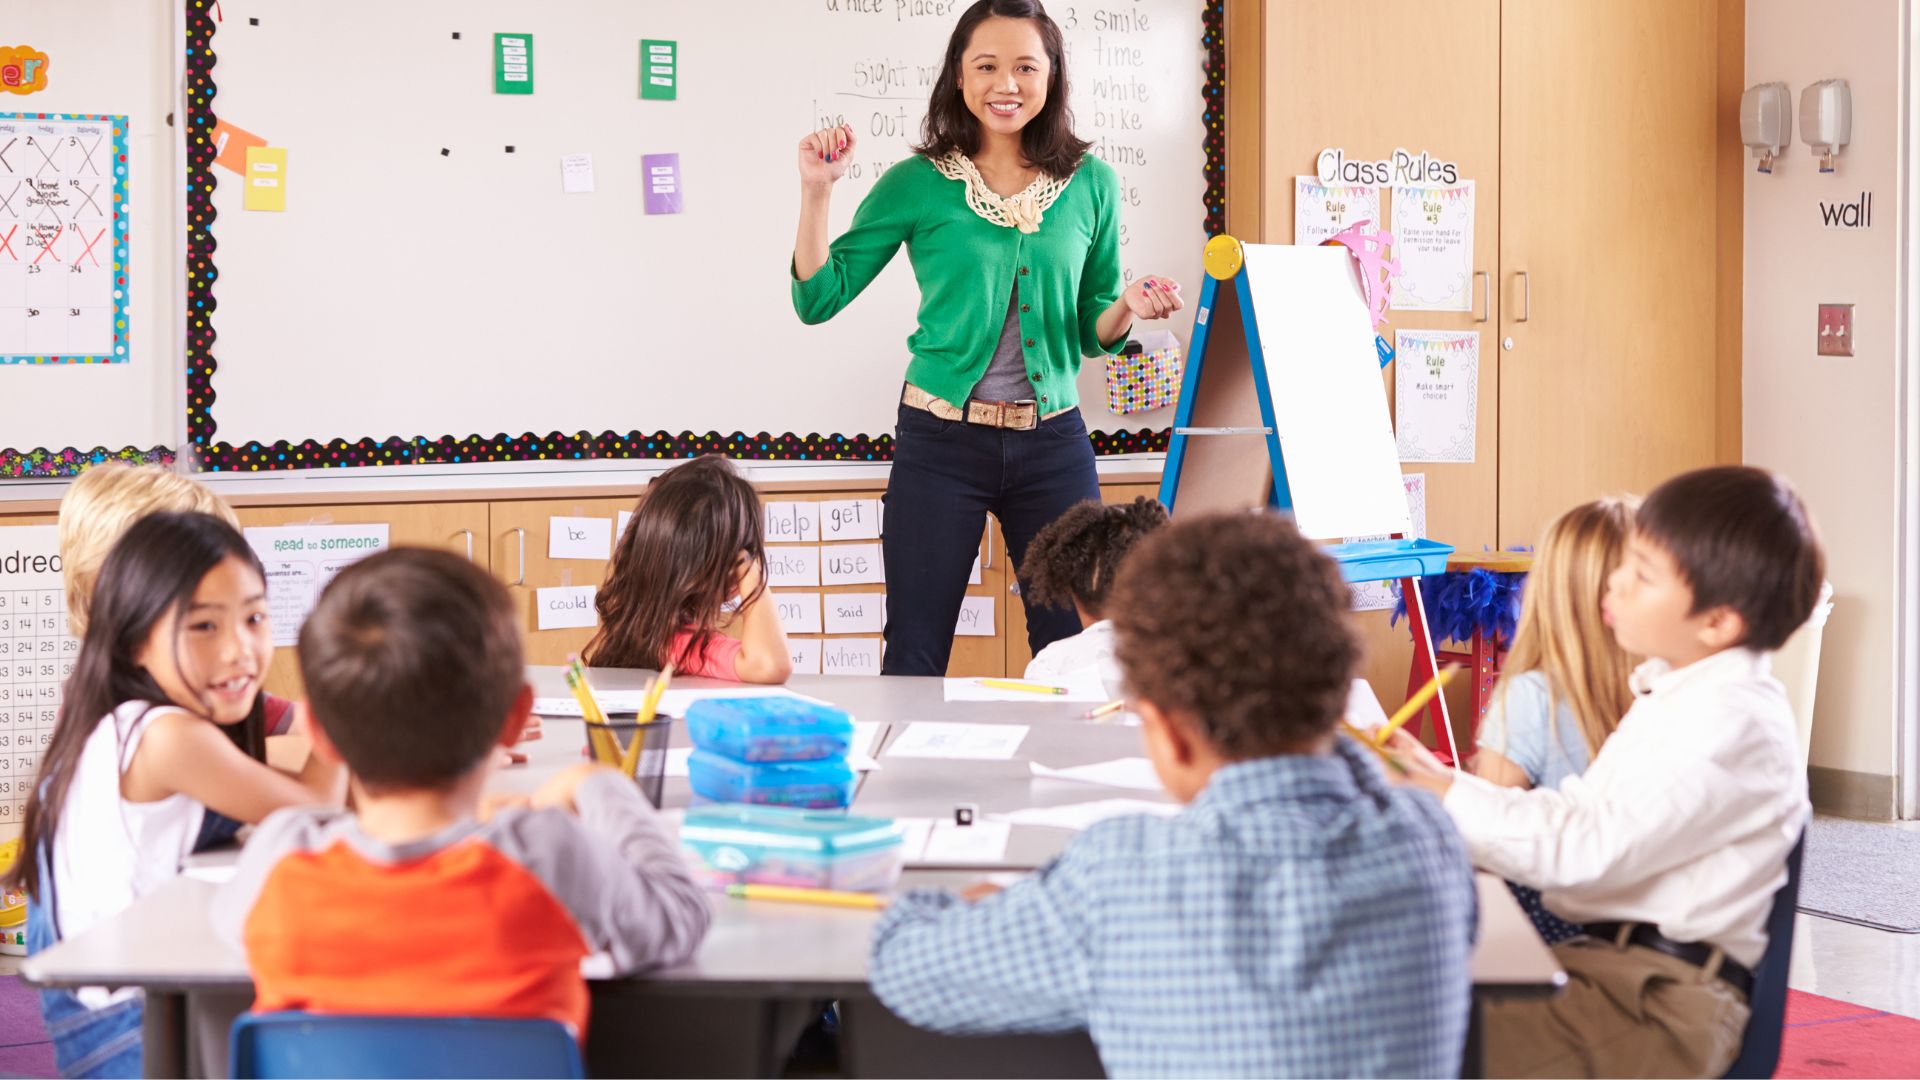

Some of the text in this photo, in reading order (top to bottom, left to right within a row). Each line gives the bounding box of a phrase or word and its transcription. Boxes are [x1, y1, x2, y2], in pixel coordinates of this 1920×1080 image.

[1092, 36, 1144, 67] time
[1092, 75, 1150, 103] white
[1094, 101, 1143, 130] bike
[1095, 136, 1147, 166] dime
[1321, 150, 1458, 185] Class Rules
[1326, 201, 1346, 212] Rule
[1423, 201, 1442, 213] Rule
[1819, 191, 1872, 228] wall
[1307, 226, 1328, 234] Follow
[28, 265, 41, 274] 23
[70, 265, 82, 273] 24
[27, 307, 40, 317] 30
[1426, 355, 1445, 367] Rule
[1423, 391, 1447, 400] choices
[768, 503, 810, 541] help
[831, 501, 862, 532] get
[568, 526, 587, 541] be
[274, 537, 380, 551] Read to someone
[767, 554, 805, 574] take
[829, 556, 868, 574] use
[21, 596, 29, 606] 4
[44, 595, 52, 606] 5
[550, 595, 587, 610] could
[19, 619, 31, 629] 14
[42, 619, 55, 629] 15
[17, 642, 32, 653] 24
[40, 642, 54, 652] 25
[63, 640, 78, 651] 26
[825, 646, 871, 668] when
[17, 665, 32, 676] 34
[40, 665, 54, 675] 35
[0, 689, 10, 700] 3
[17, 689, 32, 698] 44
[40, 688, 55, 697] 45
[18, 712, 32, 722] 54
[41, 711, 55, 721] 55
[18, 736, 32, 745] 64
[0, 759, 10, 769] 3
[18, 758, 32, 768] 74
